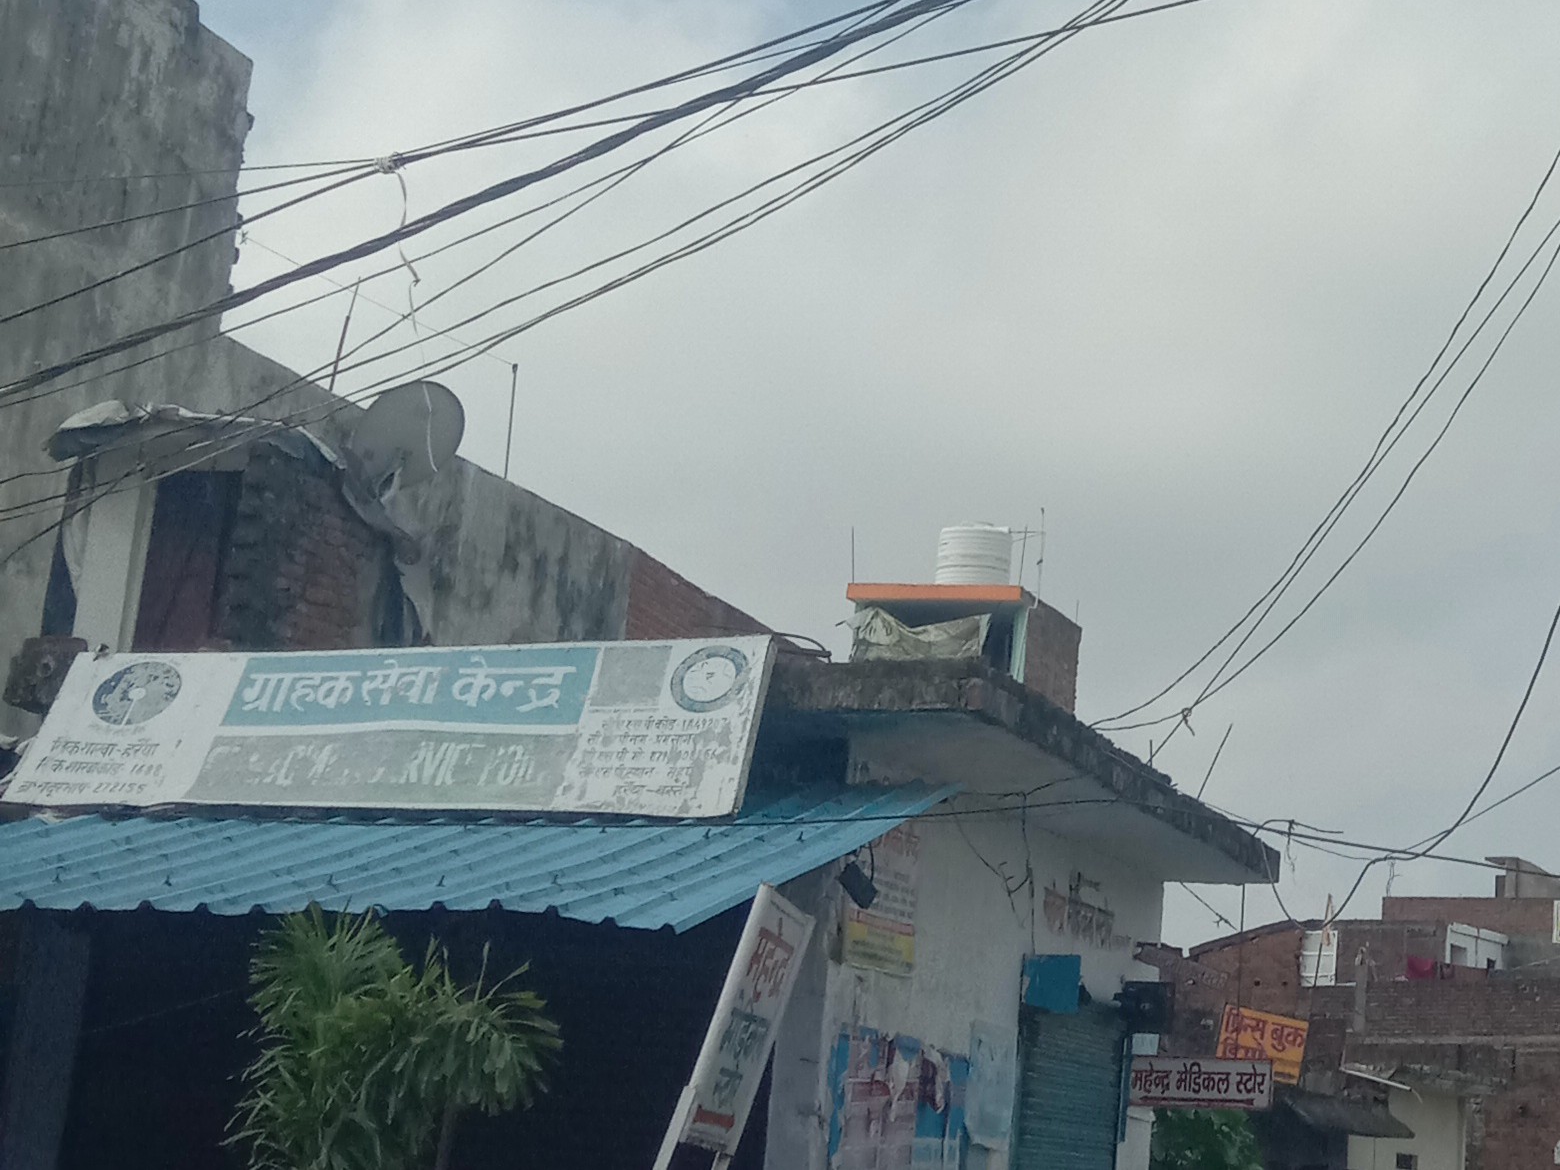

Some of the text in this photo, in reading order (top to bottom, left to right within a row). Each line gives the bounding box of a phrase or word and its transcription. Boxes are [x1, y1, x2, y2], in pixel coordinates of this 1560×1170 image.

[241, 655, 577, 713] ग्राहक सेवा केन्द्र
[1271, 1021, 1306, 1052] बुक
[1131, 1062, 1268, 1096] महेन्द्र मेडिकल स्टोर
